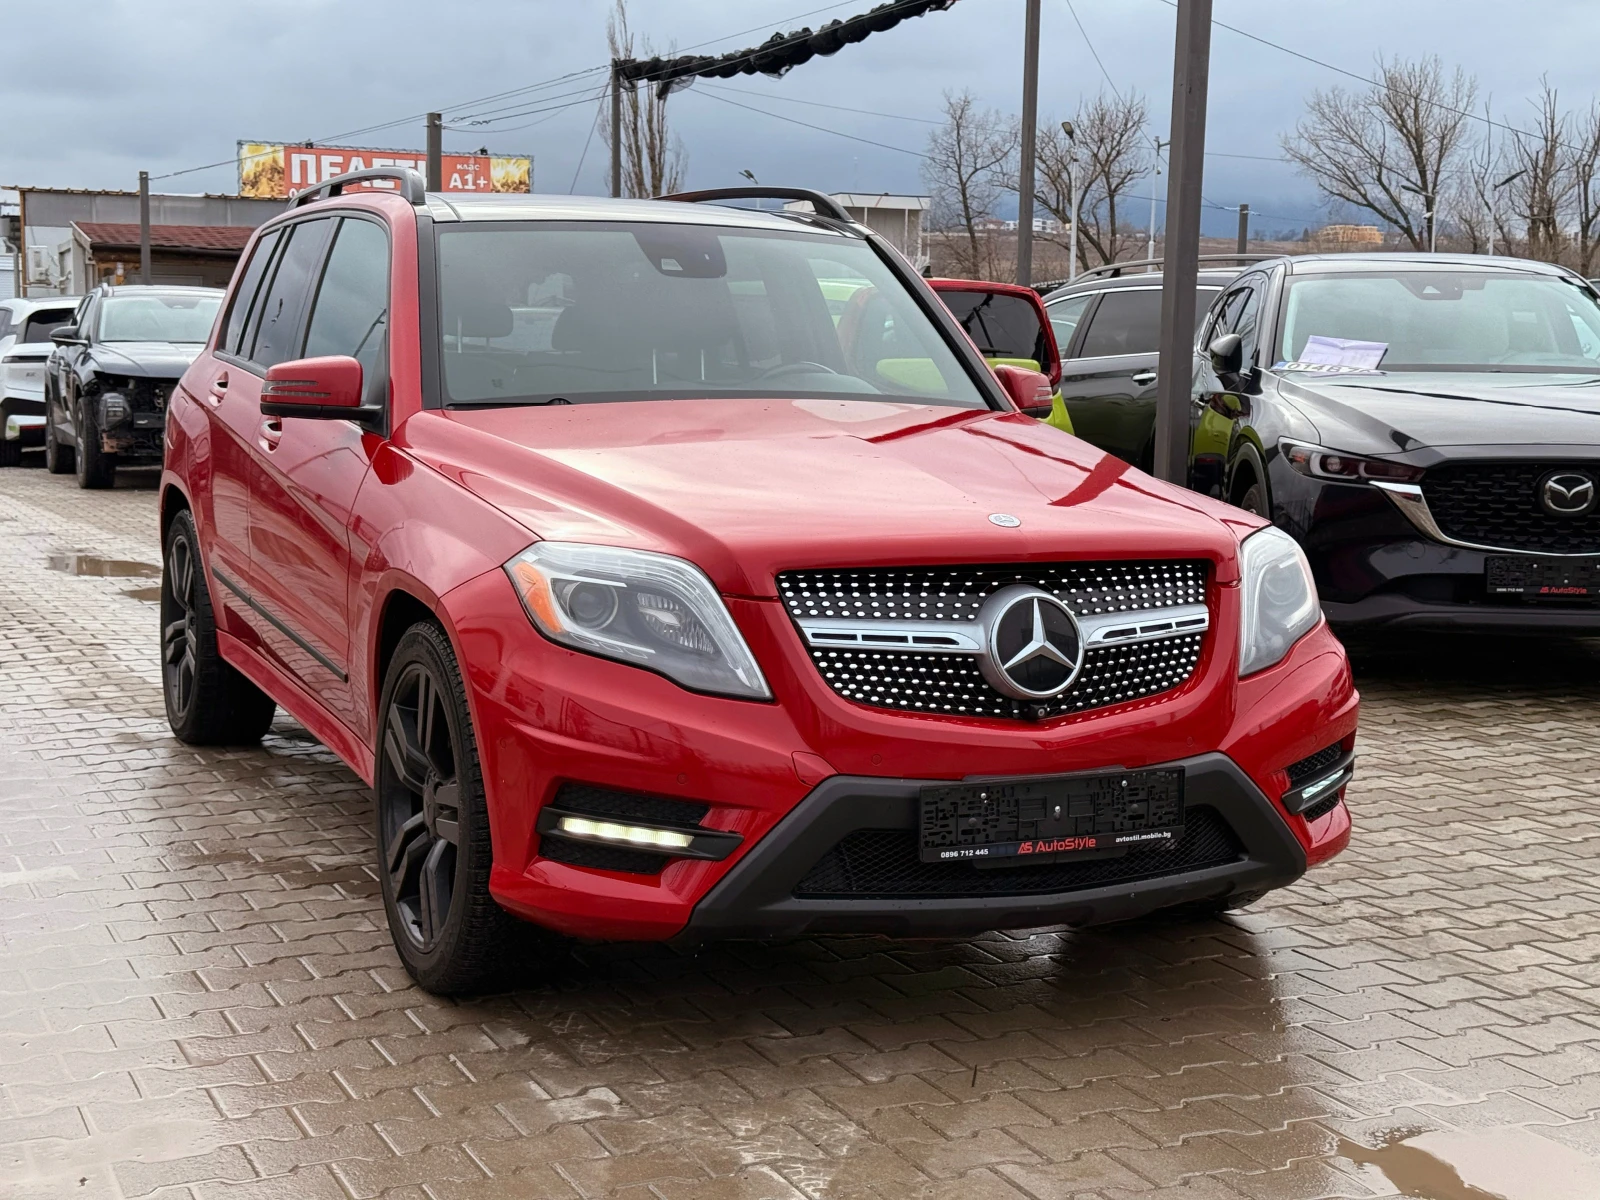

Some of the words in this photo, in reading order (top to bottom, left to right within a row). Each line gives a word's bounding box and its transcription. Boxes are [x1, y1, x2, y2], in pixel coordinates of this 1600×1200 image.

[291, 153, 427, 190] ПЕЛЕТ
[449, 172, 489, 190] A1+
[1550, 586, 1588, 595] AutoStyle
[940, 850, 959, 858] 0896
[960, 849, 974, 857] 712
[1035, 837, 1096, 854] AutoStyle
[1115, 831, 1172, 843] avtostil.mobile.bg
